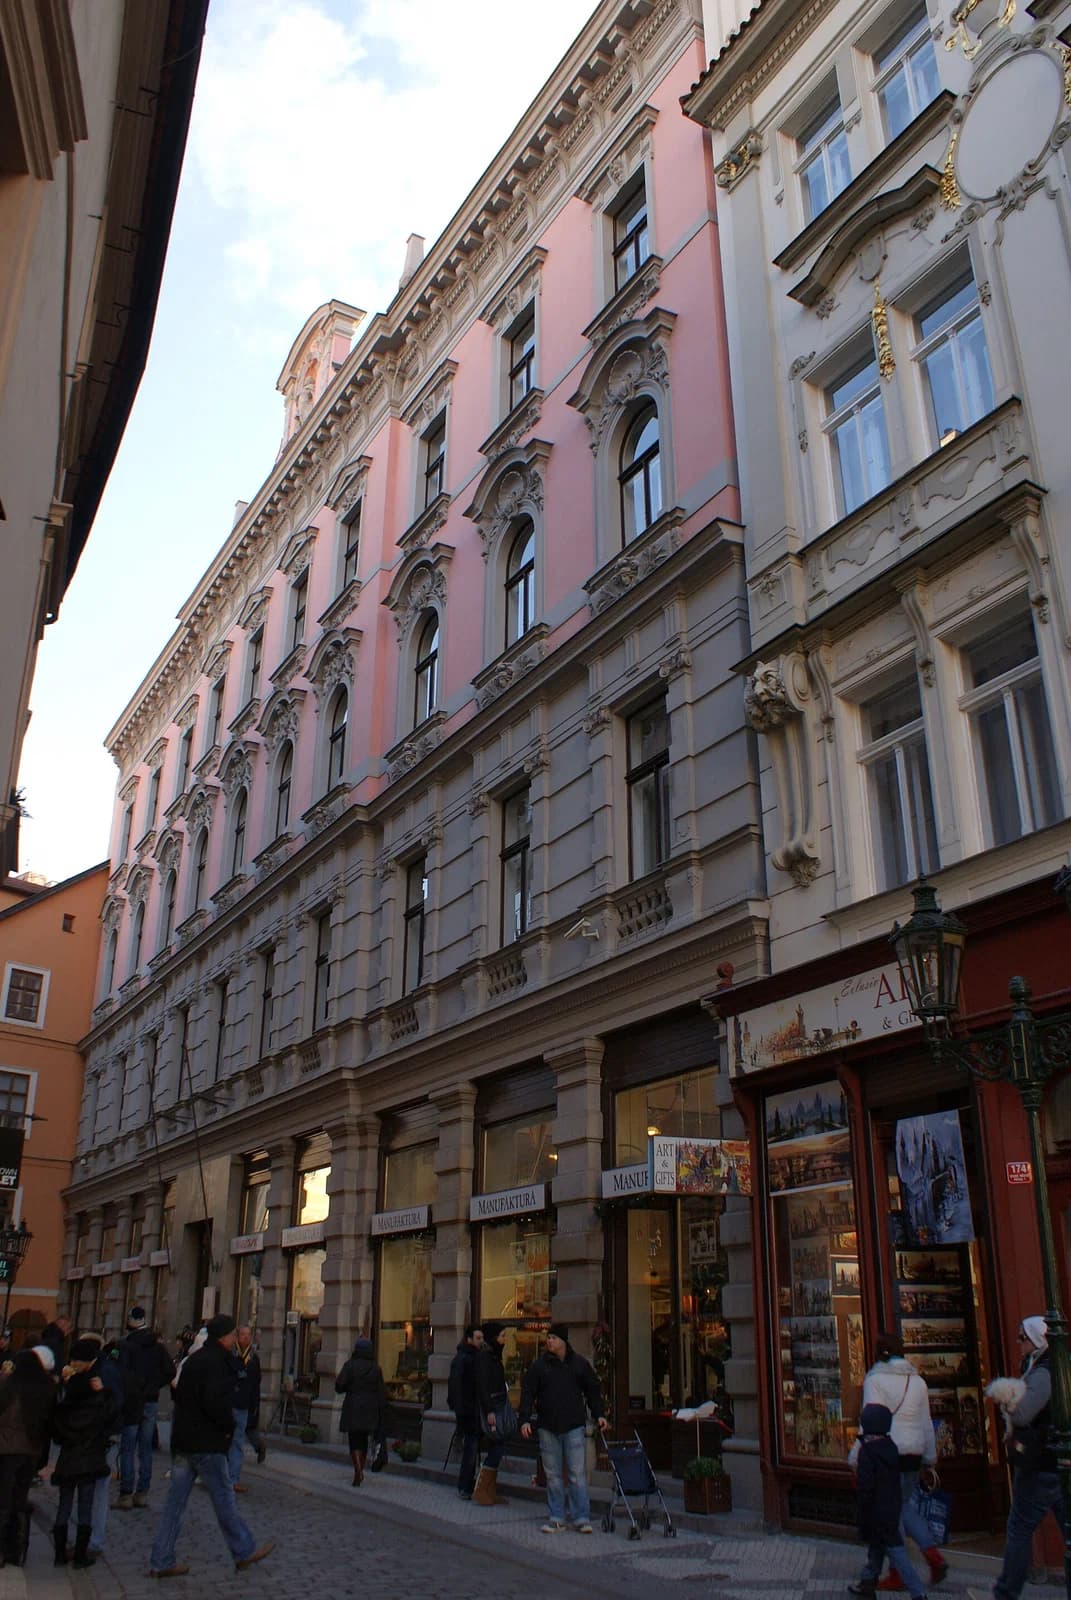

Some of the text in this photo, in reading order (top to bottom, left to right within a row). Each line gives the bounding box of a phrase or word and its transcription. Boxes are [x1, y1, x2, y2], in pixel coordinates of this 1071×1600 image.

[882, 1016, 892, 1030] &
[656, 1143, 674, 1158] ART
[661, 1159, 669, 1169] &
[655, 1171, 674, 1187] GIFTS
[478, 1189, 537, 1215] MANUFAKTURA
[377, 1211, 421, 1230] MANUFAKTURA
